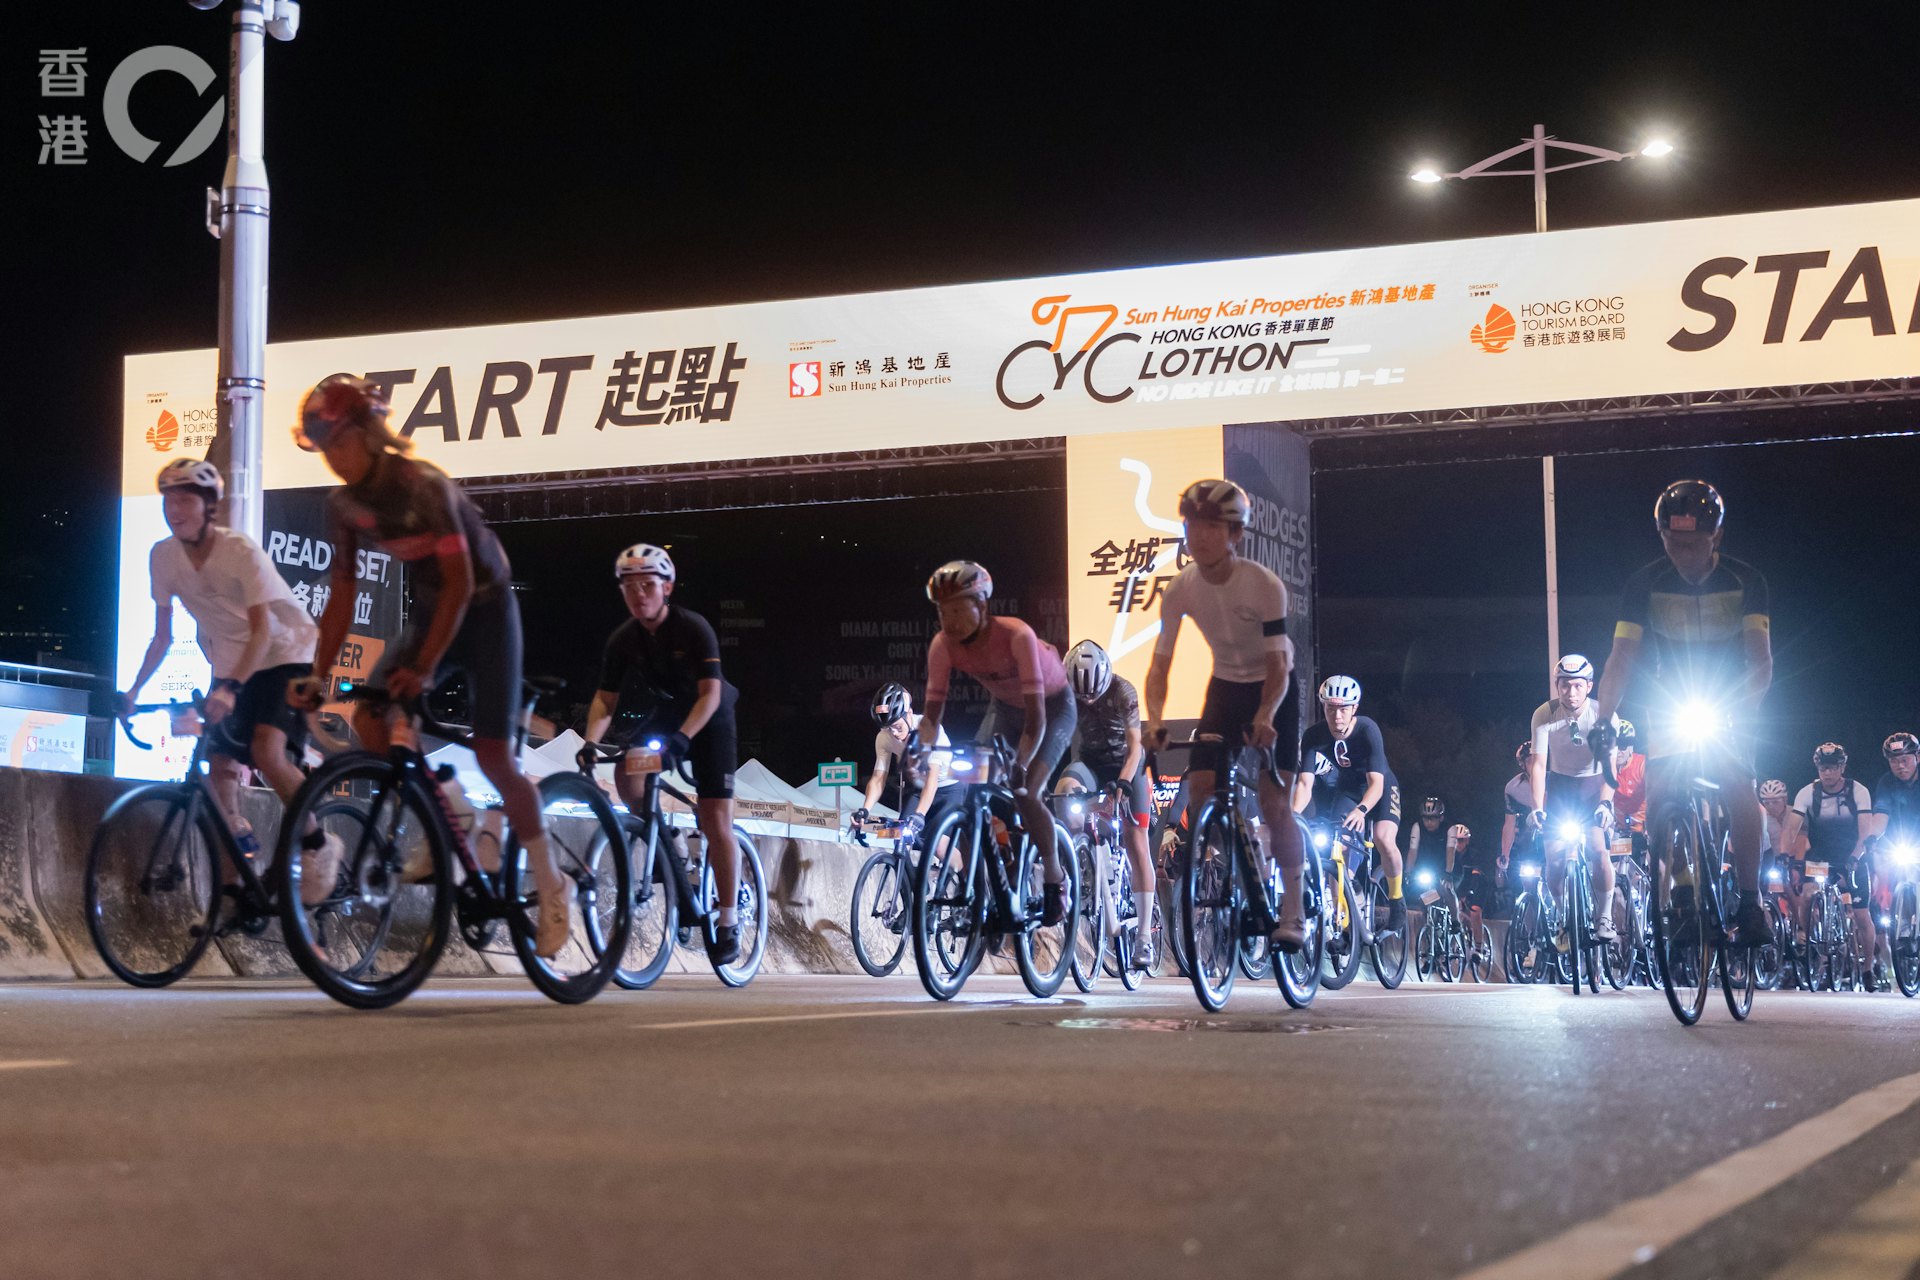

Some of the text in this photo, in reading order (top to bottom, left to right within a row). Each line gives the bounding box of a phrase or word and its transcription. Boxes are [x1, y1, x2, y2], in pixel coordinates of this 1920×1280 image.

[1124, 283, 1437, 326] Sun Hung Kai Properties 新鴻基地產
[1521, 296, 1625, 318] HONG KONG
[1666, 246, 1920, 352] STA
[1150, 316, 1336, 345] HONG KONG 香港單車節
[1522, 313, 1625, 331] TOURISM BOARD
[1522, 327, 1626, 348] 香港旅遊發展局
[362, 342, 748, 442] TART 起點
[828, 374, 952, 393] Sun Hung Kai Properties
[183, 408, 218, 422] HONG
[1246, 491, 1307, 549] BRIDGES
[266, 530, 392, 588] READ SET,
[1243, 529, 1307, 588] TUNNELS
[292, 580, 373, 626] 各就位
[1286, 591, 1308, 616] UTES
[840, 621, 880, 638] DIANA
[881, 620, 923, 637] KRALL
[825, 664, 860, 682] SONG
[160, 682, 195, 691] SEIKO
